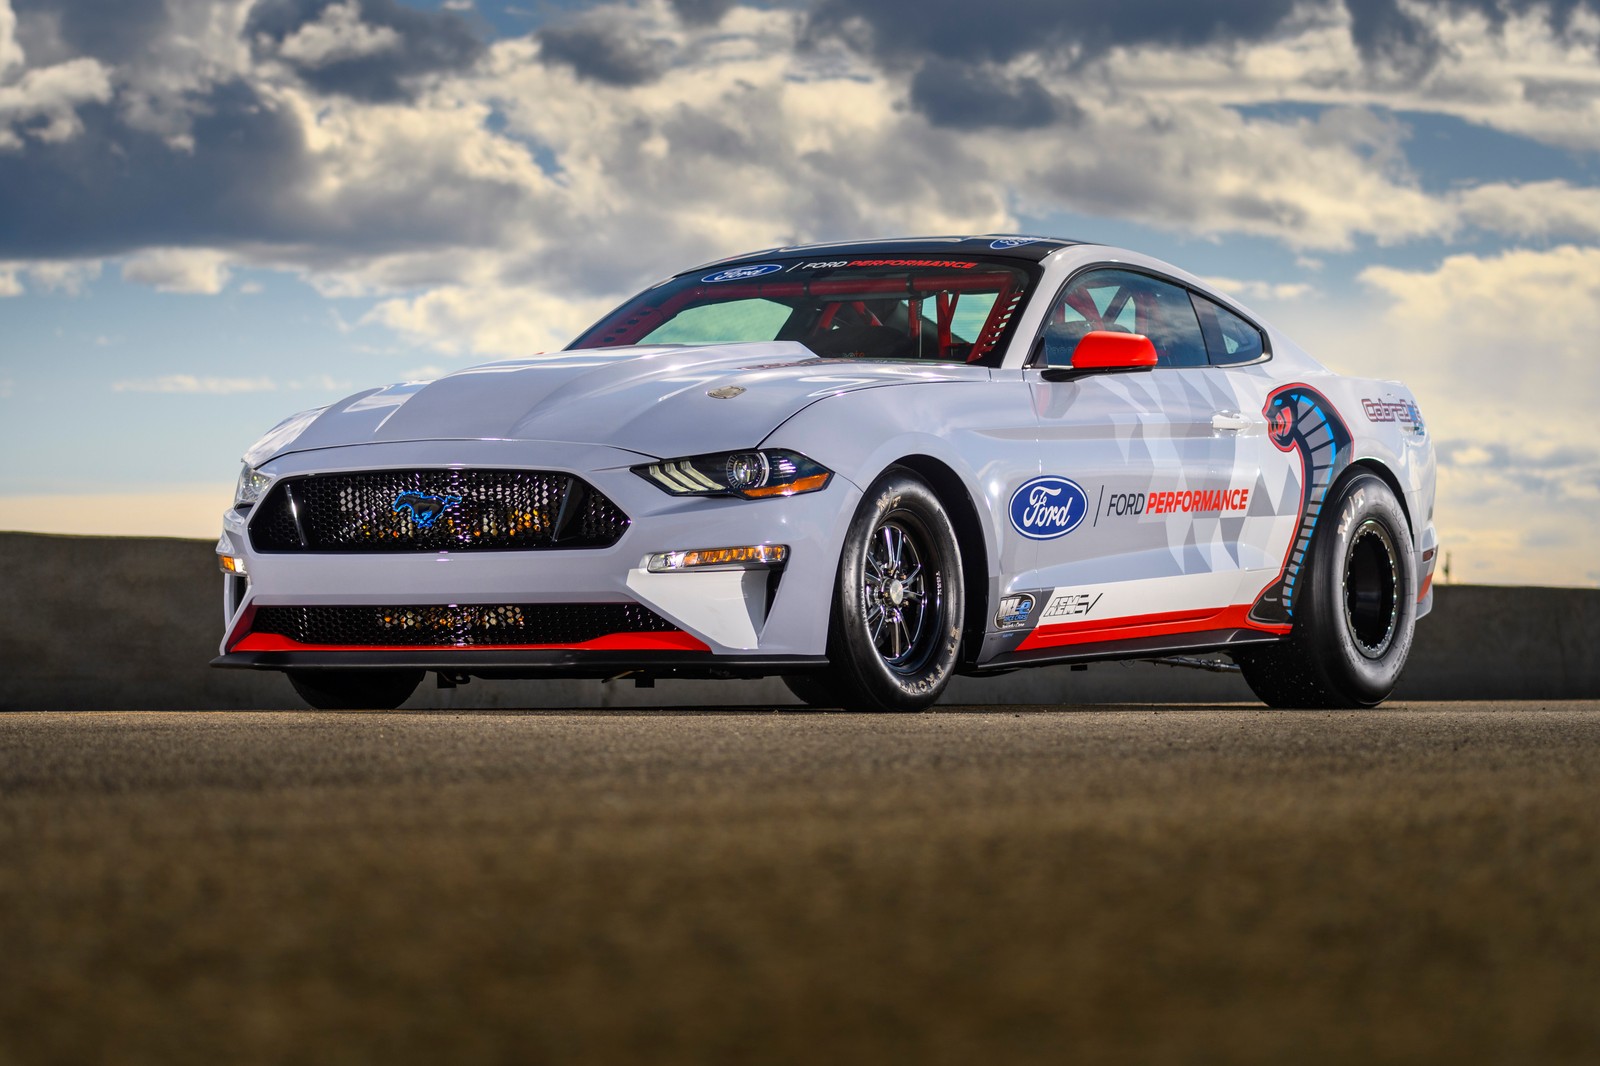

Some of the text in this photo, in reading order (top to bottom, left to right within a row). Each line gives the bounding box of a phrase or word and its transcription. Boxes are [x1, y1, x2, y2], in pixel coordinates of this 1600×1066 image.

[714, 266, 768, 281] Ford
[802, 260, 977, 269] FORD PERFORMANCE
[1022, 485, 1073, 528] Ford
[1107, 488, 1249, 517] FORD PERFORMANCE
